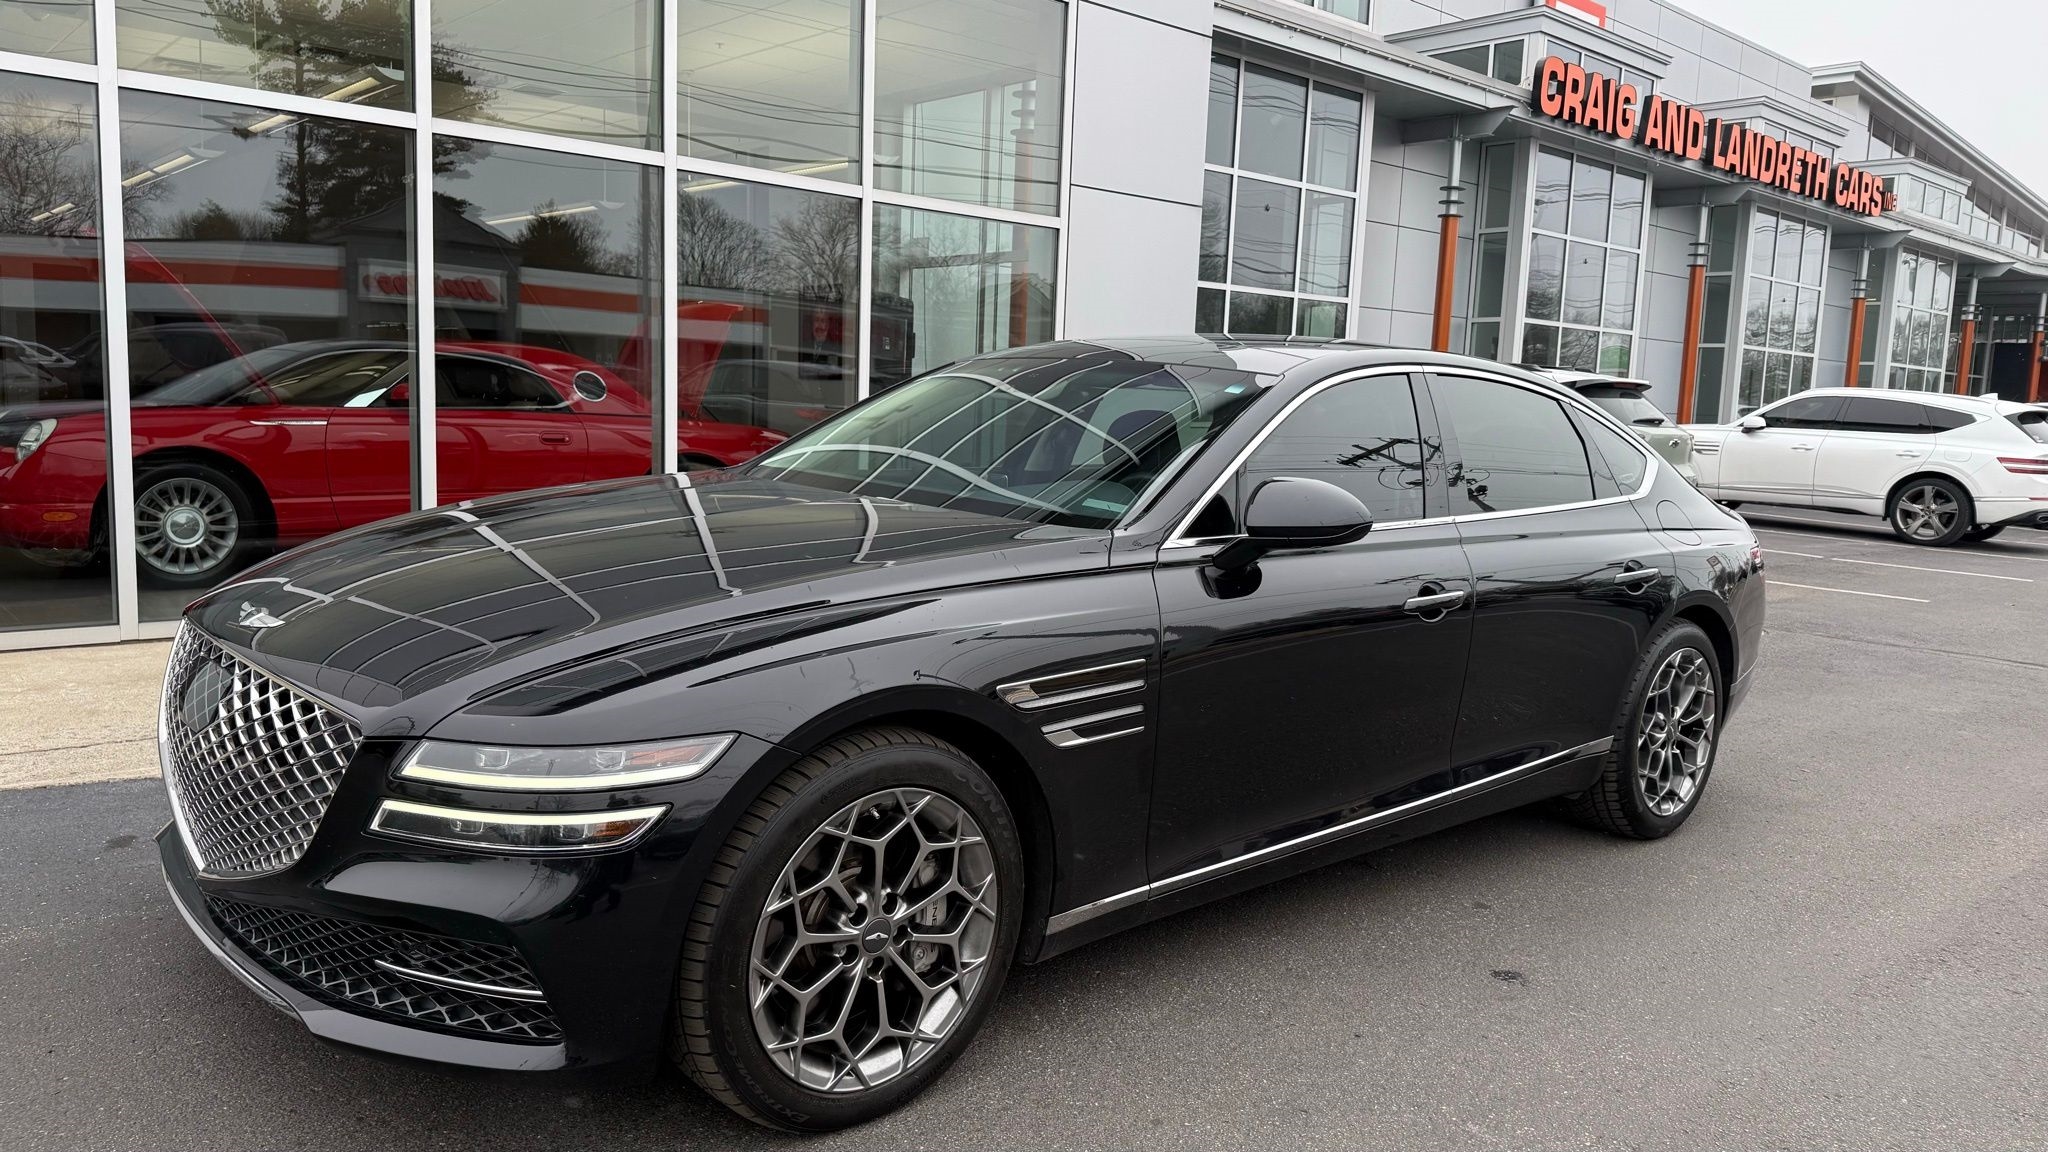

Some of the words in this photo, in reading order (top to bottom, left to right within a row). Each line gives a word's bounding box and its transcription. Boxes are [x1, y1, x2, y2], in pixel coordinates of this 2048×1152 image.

[1540, 55, 1637, 140] CRAIG
[1644, 94, 1704, 161] AND
[1713, 117, 1831, 201] LANDRETH
[1835, 162, 1883, 217] CARS
